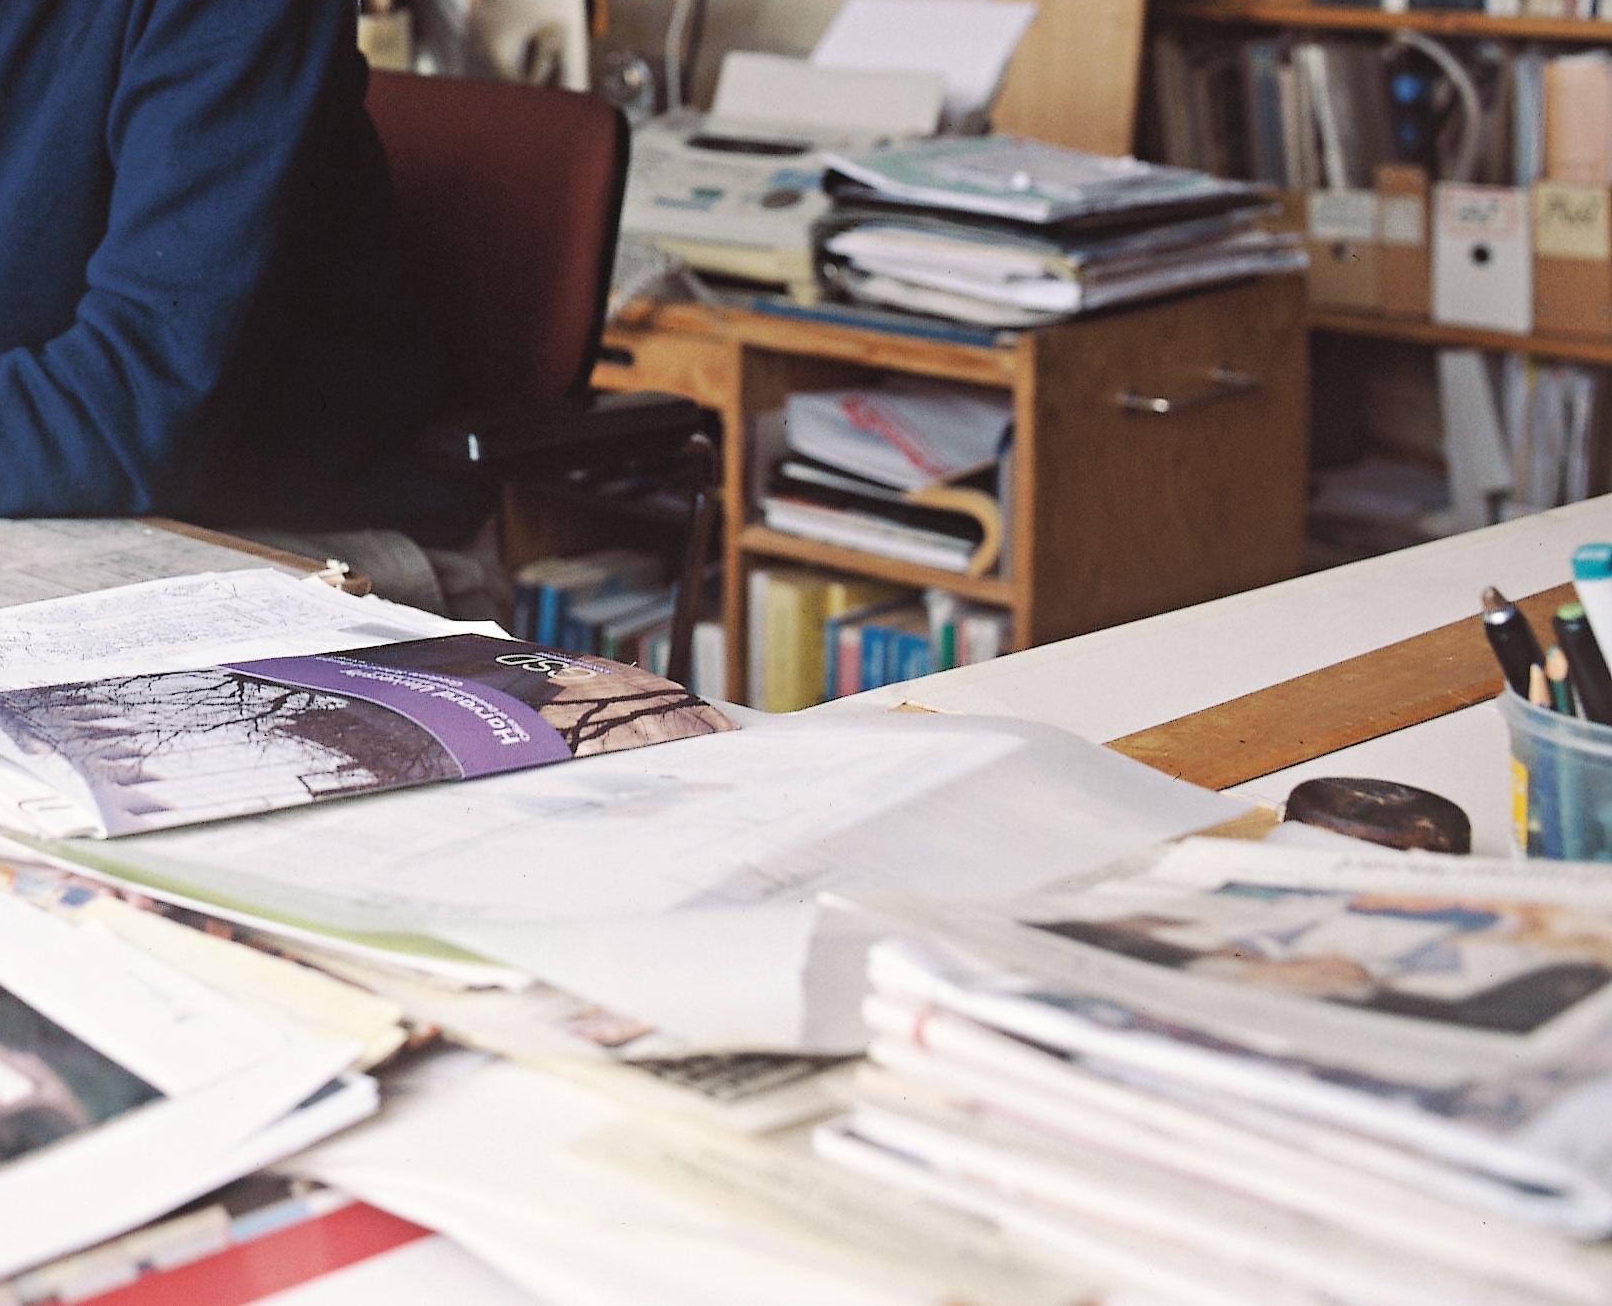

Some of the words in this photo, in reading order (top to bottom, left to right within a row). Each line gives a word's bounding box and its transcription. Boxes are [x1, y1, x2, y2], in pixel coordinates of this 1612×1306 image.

[339, 669, 435, 693] University
[495, 653, 597, 681] GSD
[431, 690, 512, 746] Harvard
